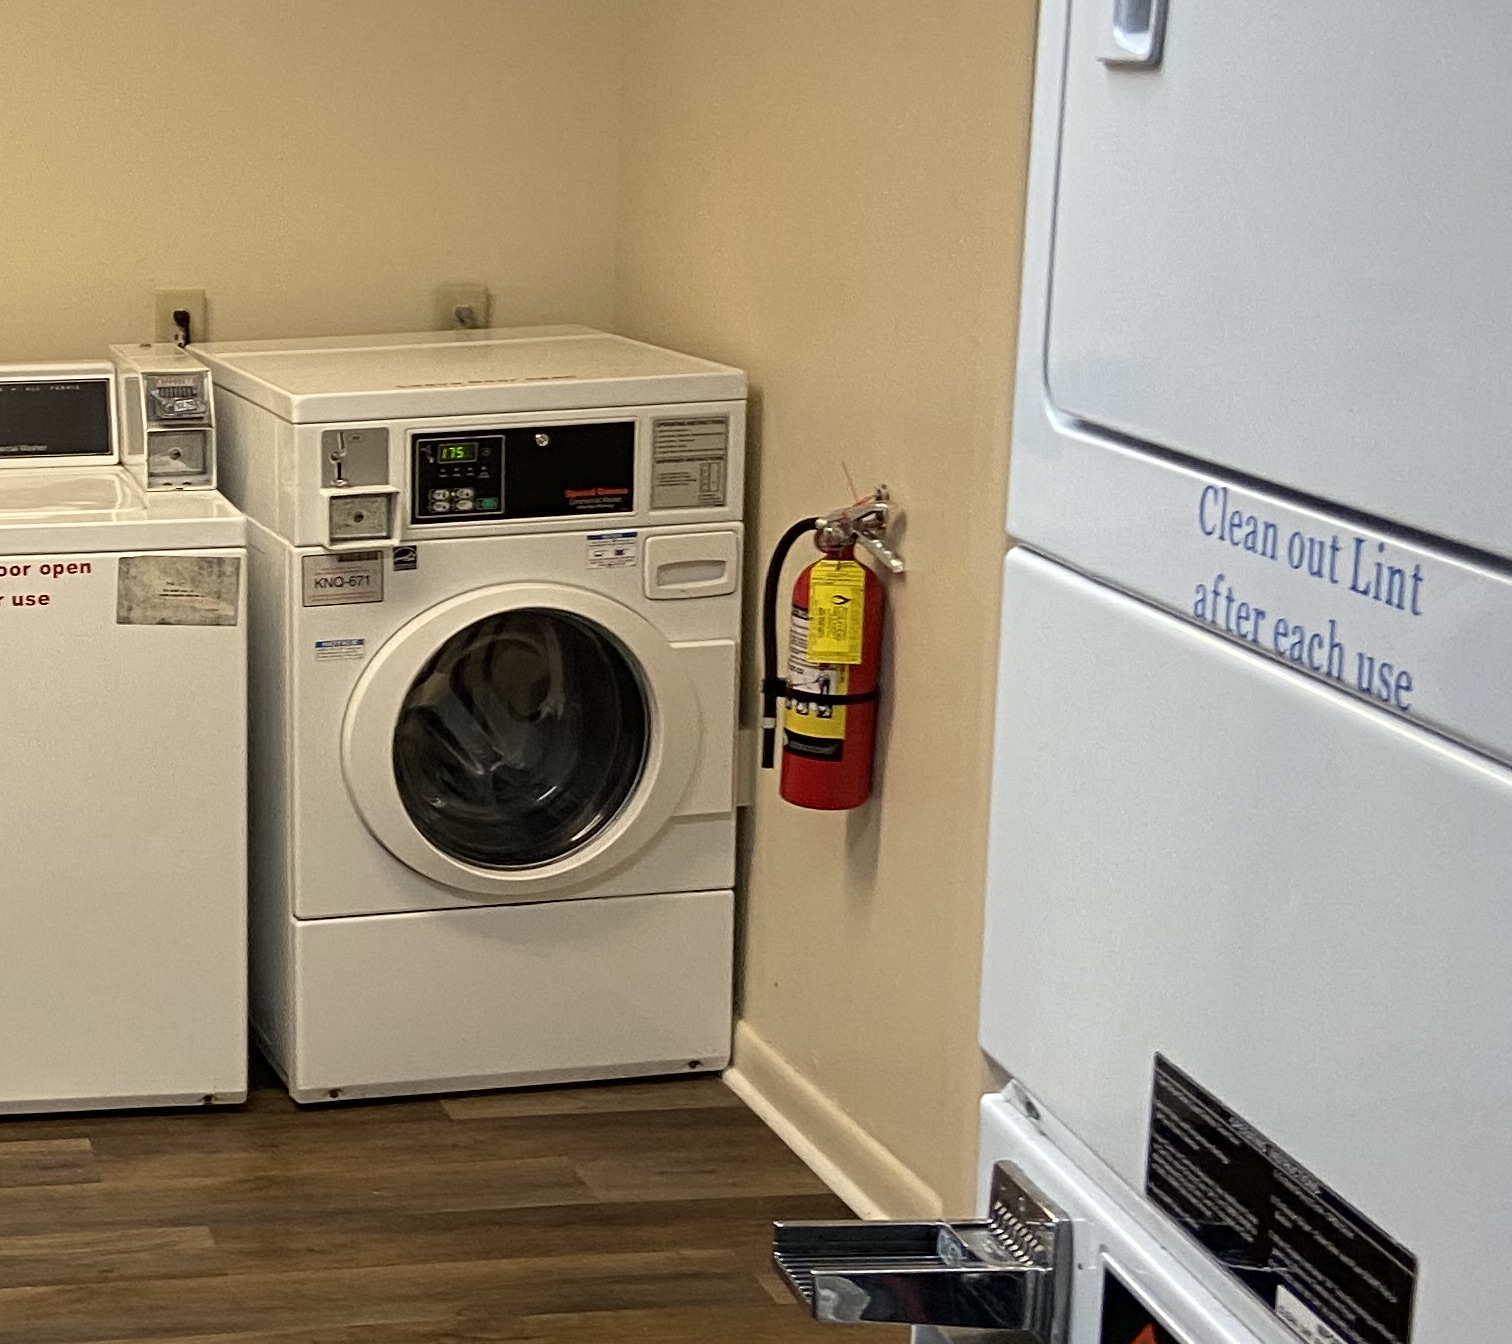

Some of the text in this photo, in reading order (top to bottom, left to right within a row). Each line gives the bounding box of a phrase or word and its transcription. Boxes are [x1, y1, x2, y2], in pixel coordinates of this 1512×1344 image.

[39, 562, 92, 579] open
[1199, 484, 1424, 616] Clean out Lint
[12, 593, 51, 607] use
[1193, 573, 1414, 712] after each use
